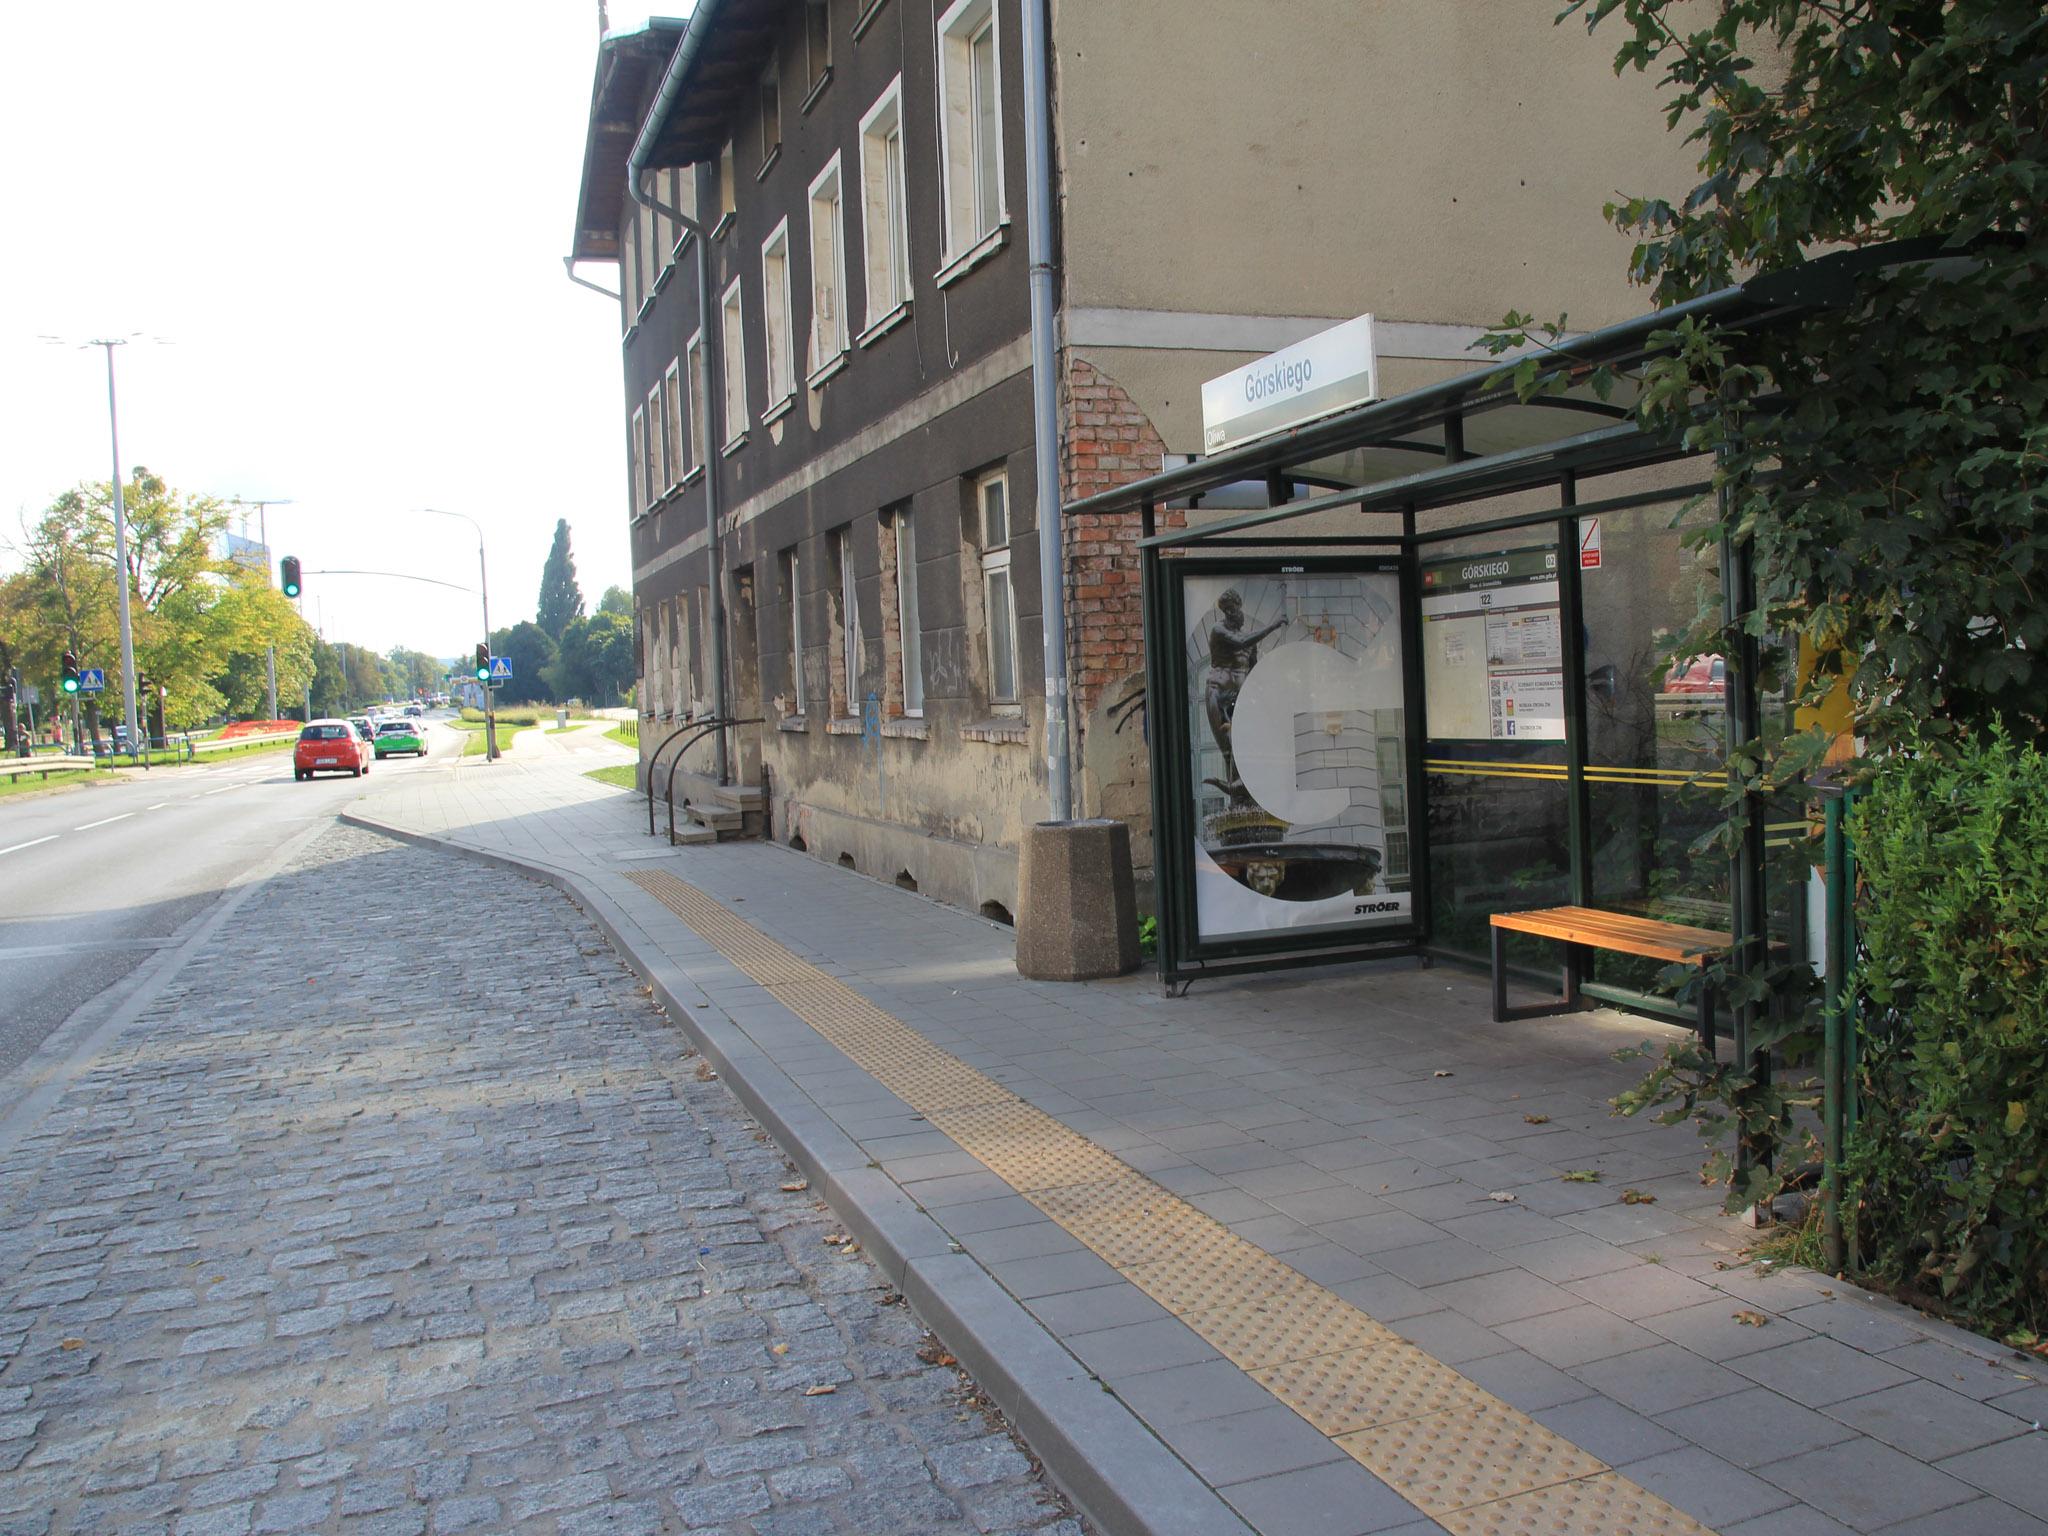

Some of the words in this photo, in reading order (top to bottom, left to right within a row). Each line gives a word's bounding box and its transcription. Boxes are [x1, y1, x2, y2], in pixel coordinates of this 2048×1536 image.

[1245, 358, 1312, 402] Górskiego
[1206, 429, 1226, 446] Oliwa
[1461, 561, 1509, 580] GÓRSKIEGO
[1480, 594, 1491, 605] 122
[1354, 901, 1400, 915] STRÖER
